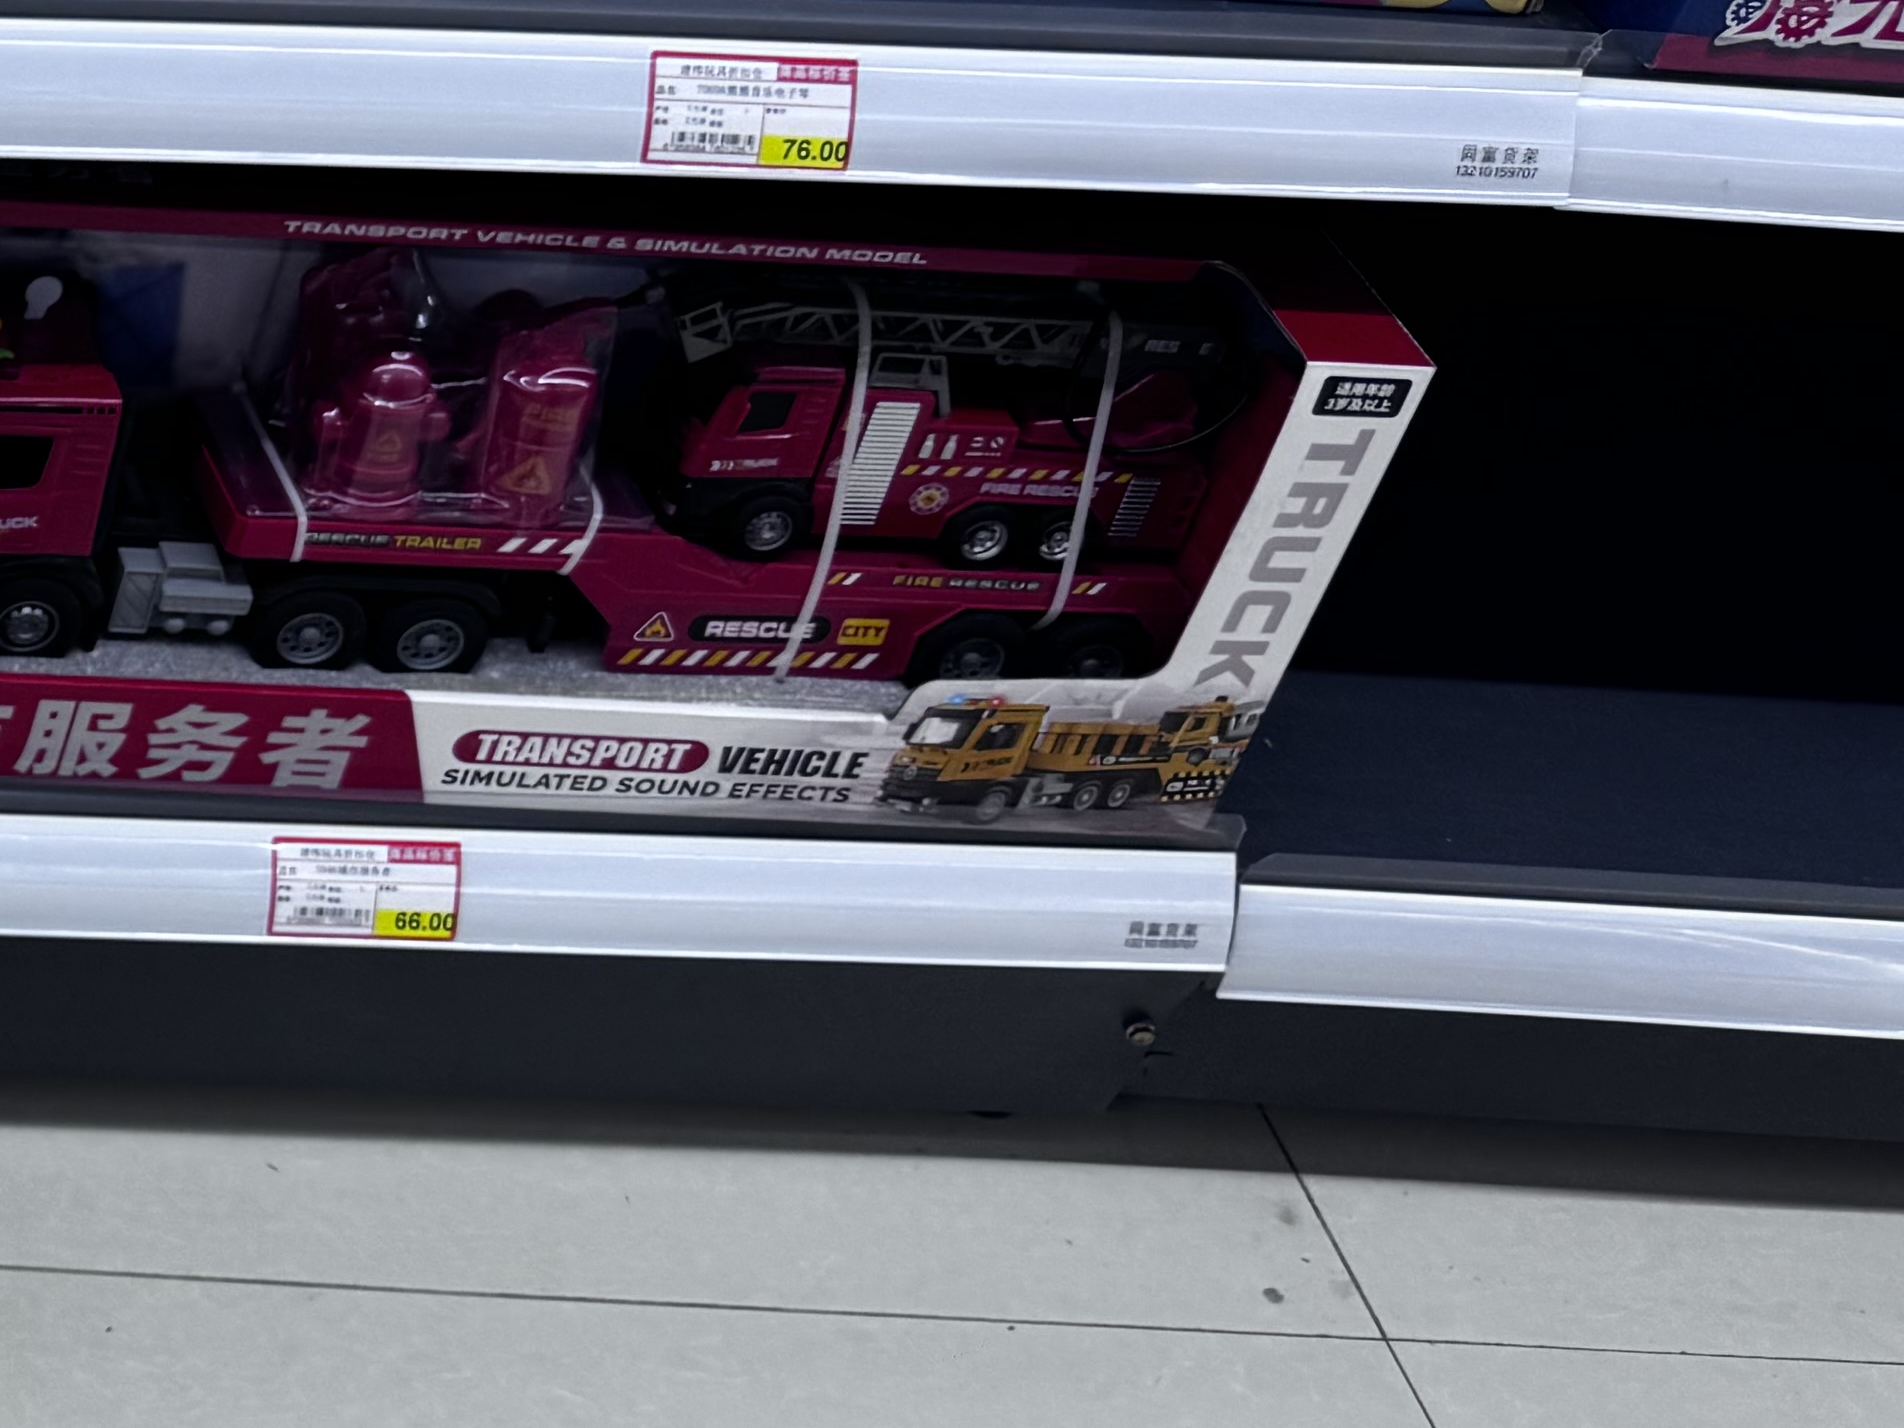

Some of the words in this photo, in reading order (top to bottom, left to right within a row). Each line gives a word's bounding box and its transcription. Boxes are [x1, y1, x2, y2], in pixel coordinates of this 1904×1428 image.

[782, 138, 849, 163] 76.00
[284, 219, 468, 243] TRANSPORT
[476, 229, 597, 250] VEHICLE
[606, 235, 628, 250] &
[635, 236, 819, 260] SIMULATION
[825, 246, 929, 266] MODEL
[393, 535, 483, 550] TRAILER
[1196, 427, 1378, 685] TRUCK
[473, 731, 695, 772] TRANSPORT
[717, 744, 870, 782] VEHICLE
[440, 767, 608, 797] SIMULATED
[615, 777, 721, 799] SOUND
[727, 782, 851, 804] EFFECTS
[394, 911, 457, 932] 66.00
